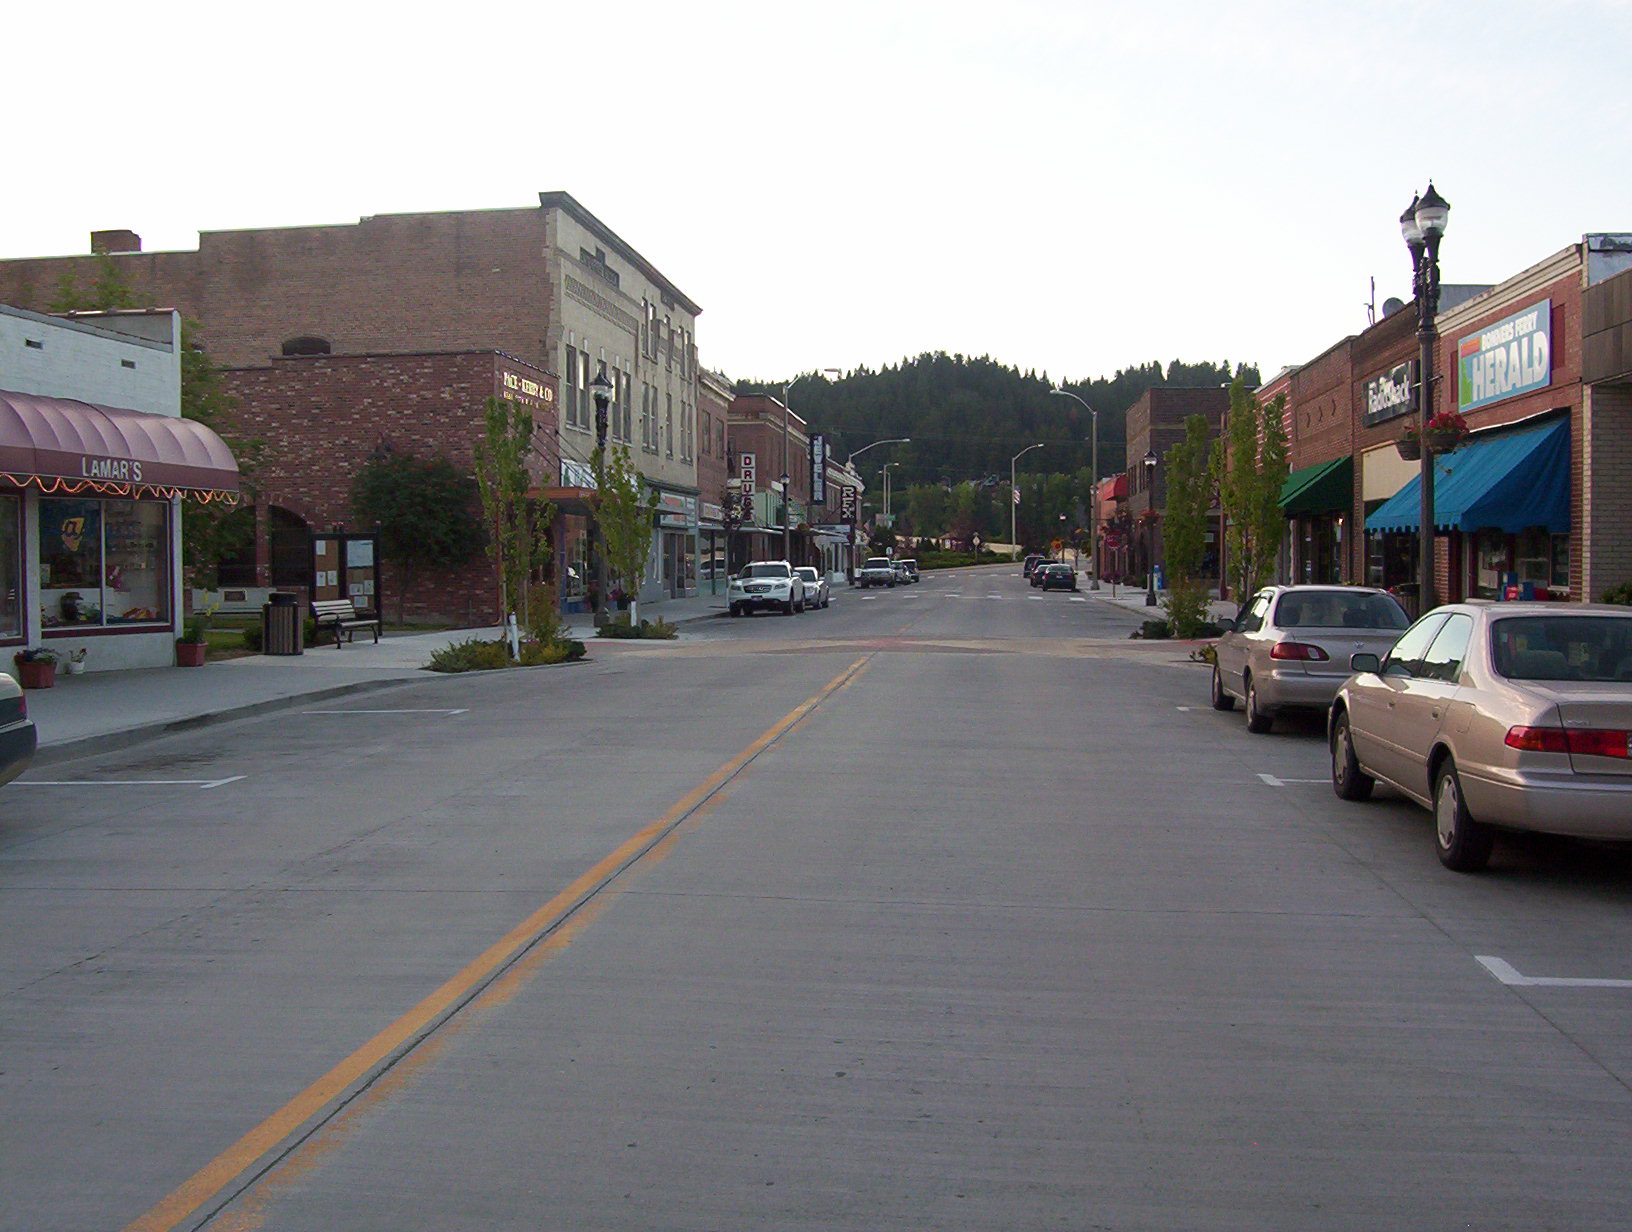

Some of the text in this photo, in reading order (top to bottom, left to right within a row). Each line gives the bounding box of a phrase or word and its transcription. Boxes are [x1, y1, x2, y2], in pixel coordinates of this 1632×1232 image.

[1515, 310, 1537, 337] FERRY
[1472, 330, 1547, 402] HERALD
[82, 456, 142, 482] LAMAR'S
[842, 486, 855, 519] REX
